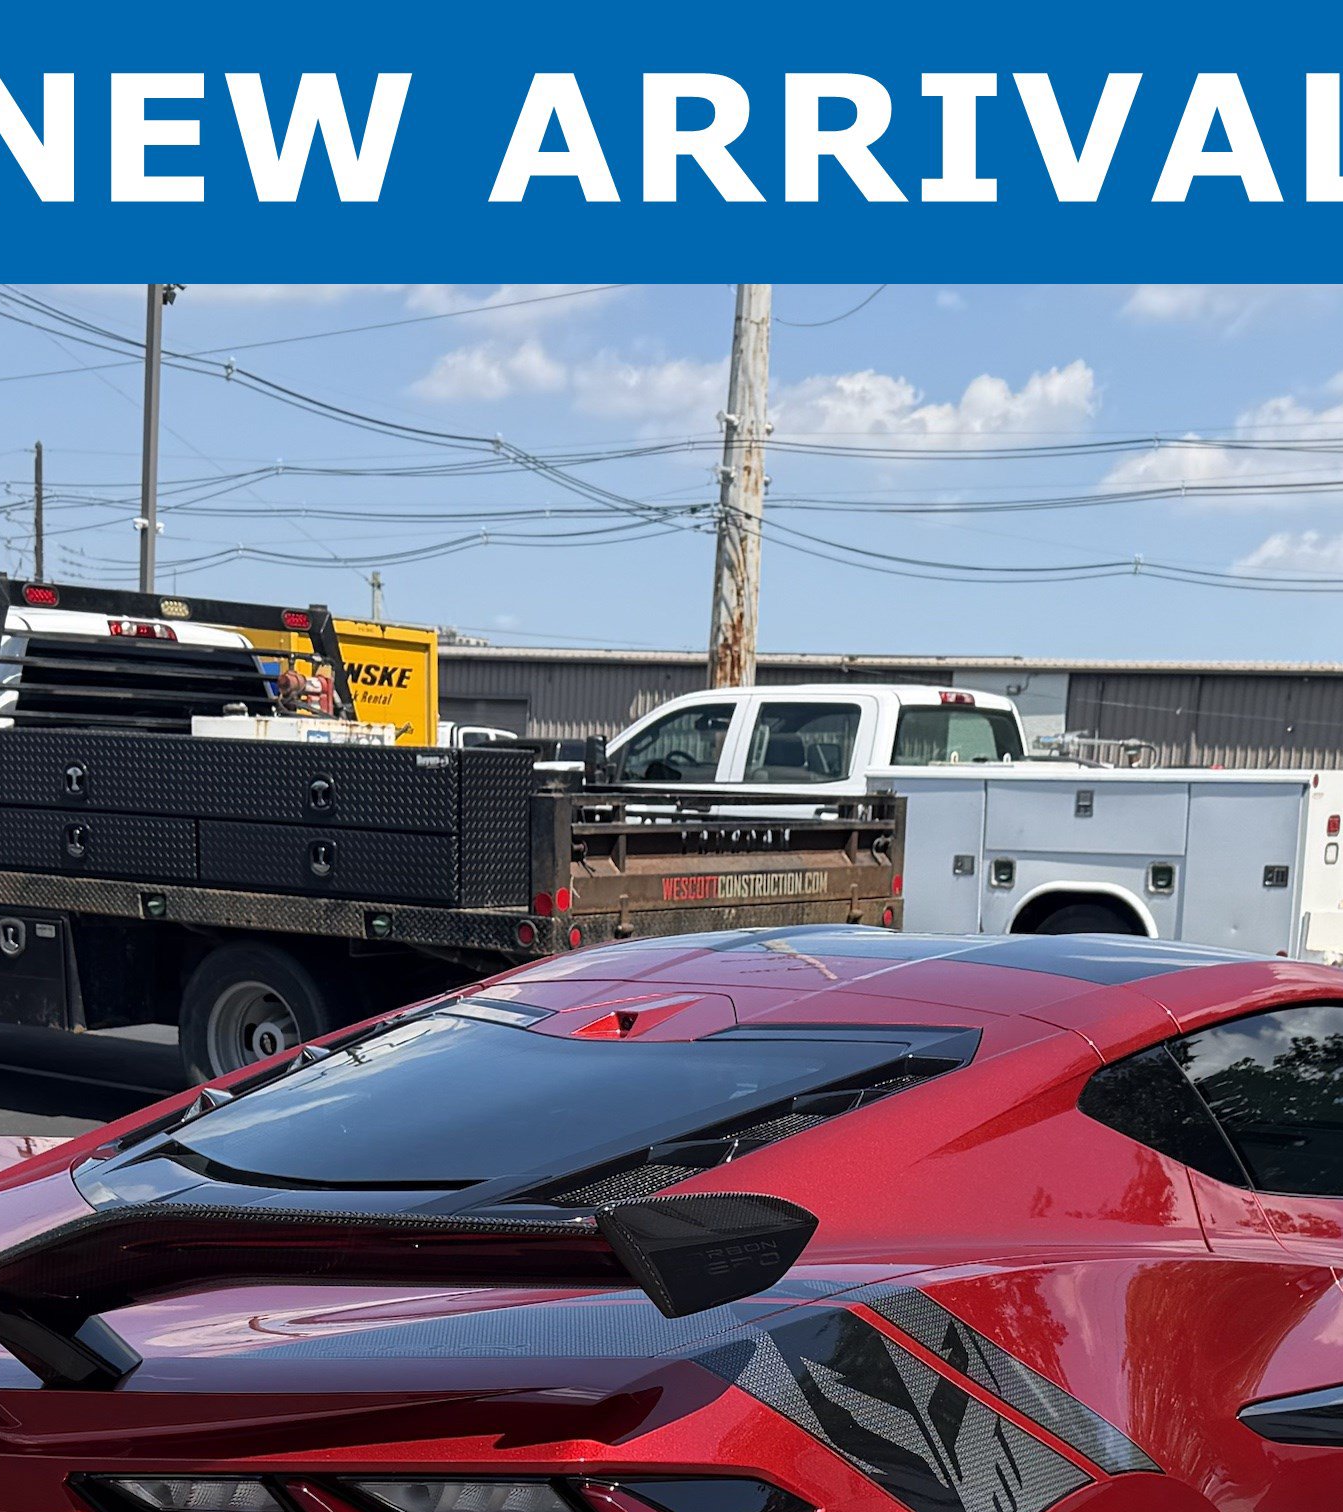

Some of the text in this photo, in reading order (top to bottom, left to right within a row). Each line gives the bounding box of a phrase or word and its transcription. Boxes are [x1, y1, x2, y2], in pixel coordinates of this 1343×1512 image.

[343, 661, 413, 689] NSKE
[361, 691, 393, 705] Rental
[662, 871, 828, 901] WESCOTTCONSTRUCTION.COM
